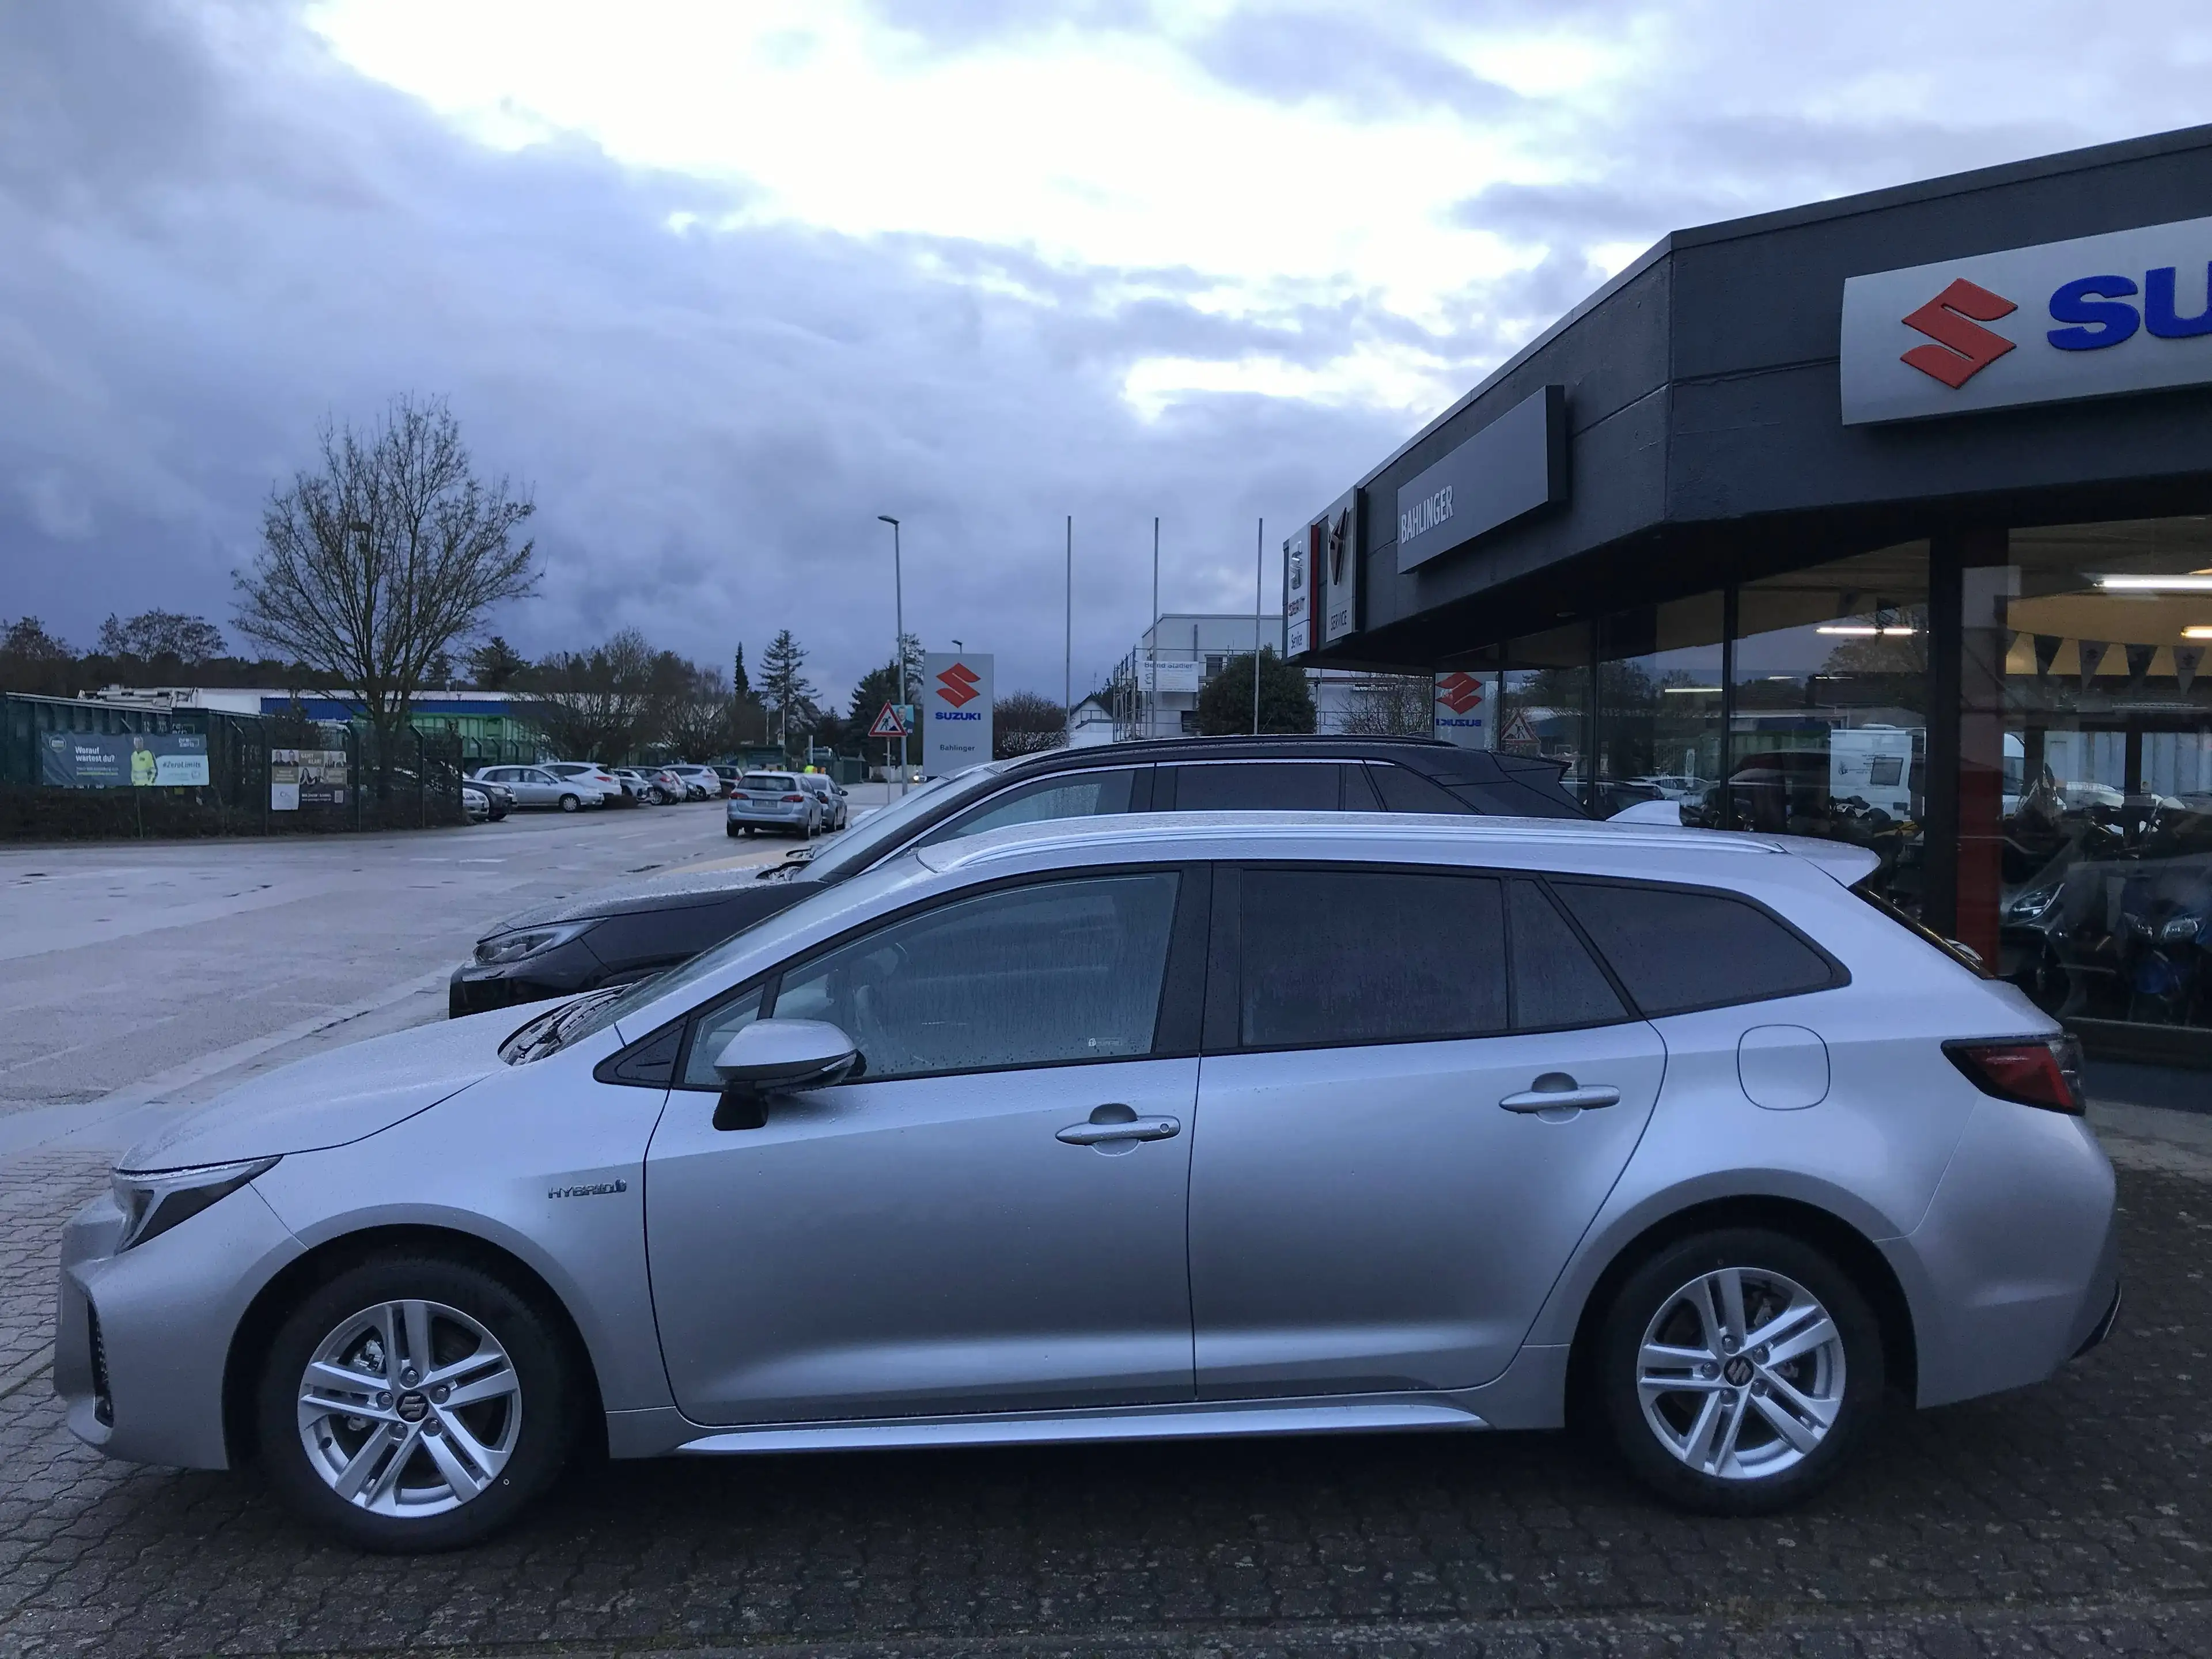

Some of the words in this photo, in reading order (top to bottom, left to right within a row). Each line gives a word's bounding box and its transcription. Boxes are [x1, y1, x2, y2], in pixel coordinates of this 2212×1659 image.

[1401, 484, 1453, 544] BAHLINGER
[1331, 609, 1347, 631] SERVICE
[1291, 631, 1302, 649] Service
[935, 712, 981, 721] SUZUKI
[75, 746, 100, 754] Worauf
[940, 744, 976, 752] Bahlinger
[75, 754, 102, 762] wartest
[103, 754, 115, 762] du?
[548, 1183, 615, 1199] HYBRID
